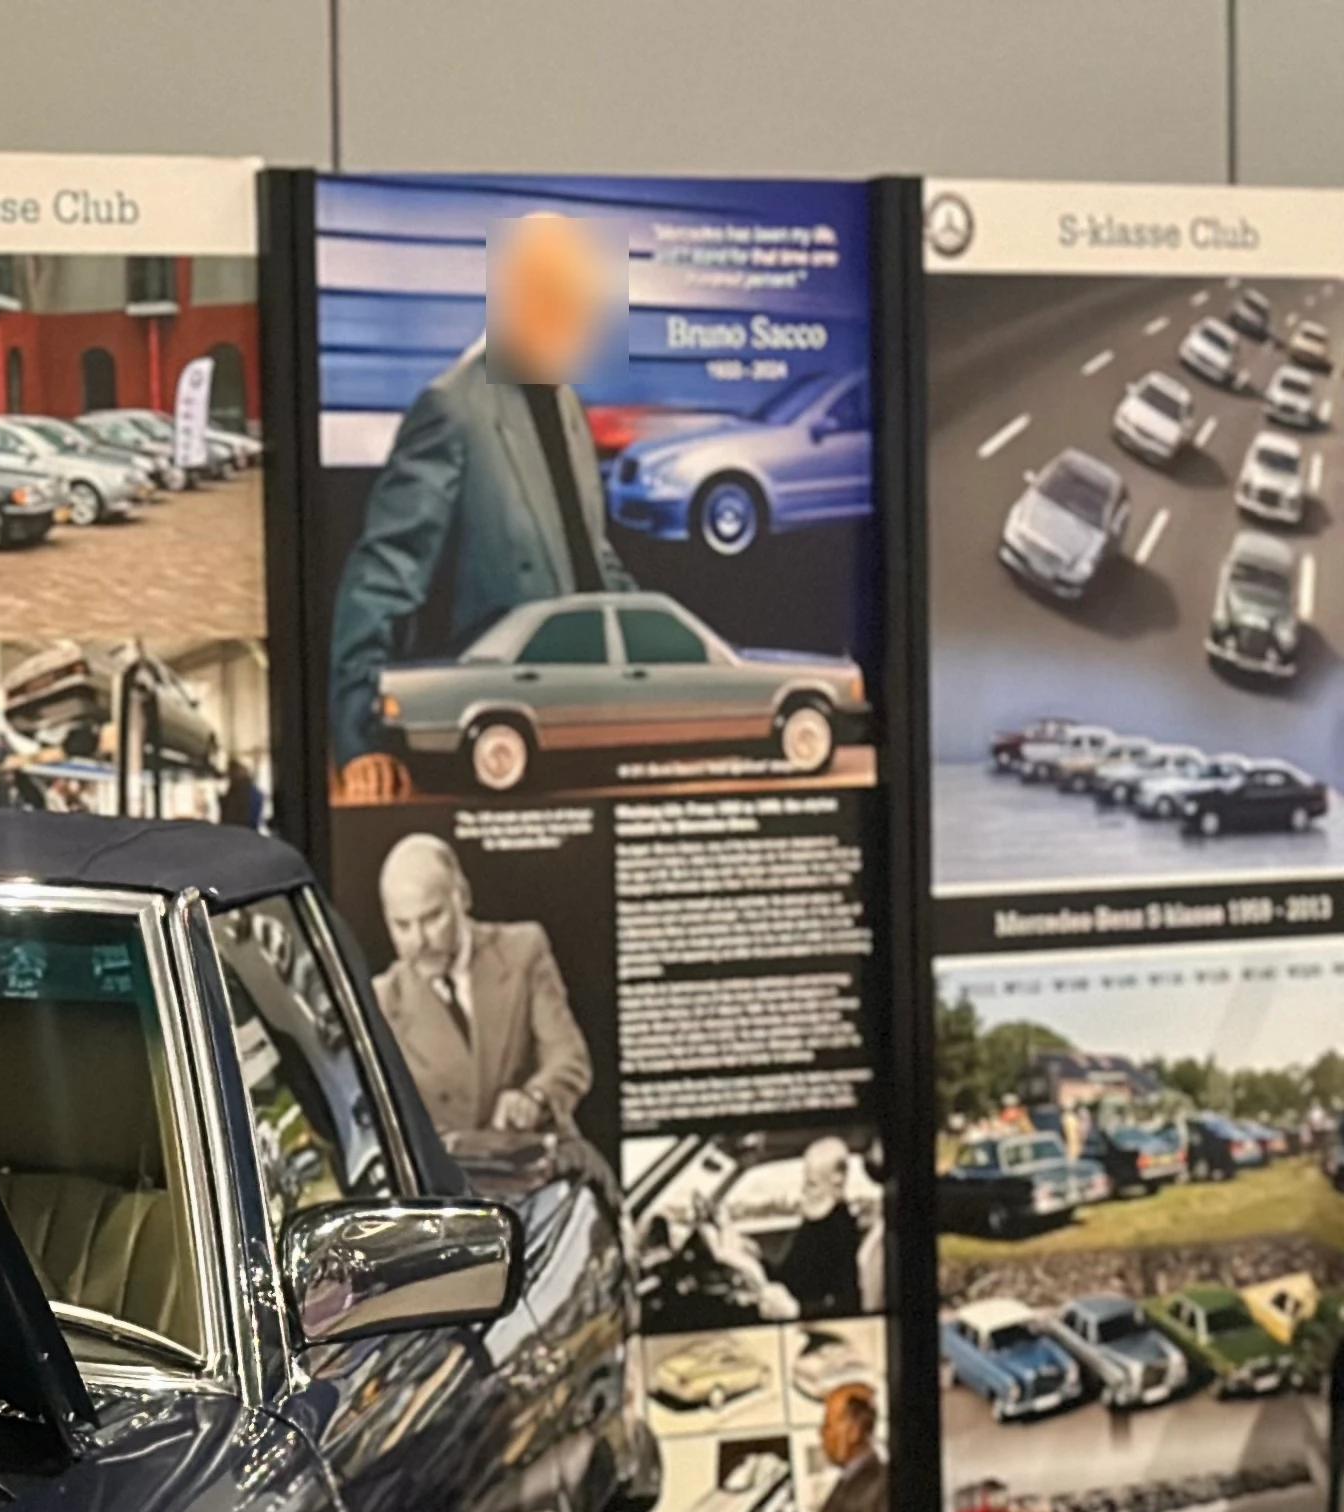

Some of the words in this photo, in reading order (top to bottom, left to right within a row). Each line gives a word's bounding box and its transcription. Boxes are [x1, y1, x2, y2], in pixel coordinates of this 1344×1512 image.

[52, 189, 140, 226] Club
[1058, 213, 1182, 250] S-klasse
[1188, 216, 1261, 251] Club
